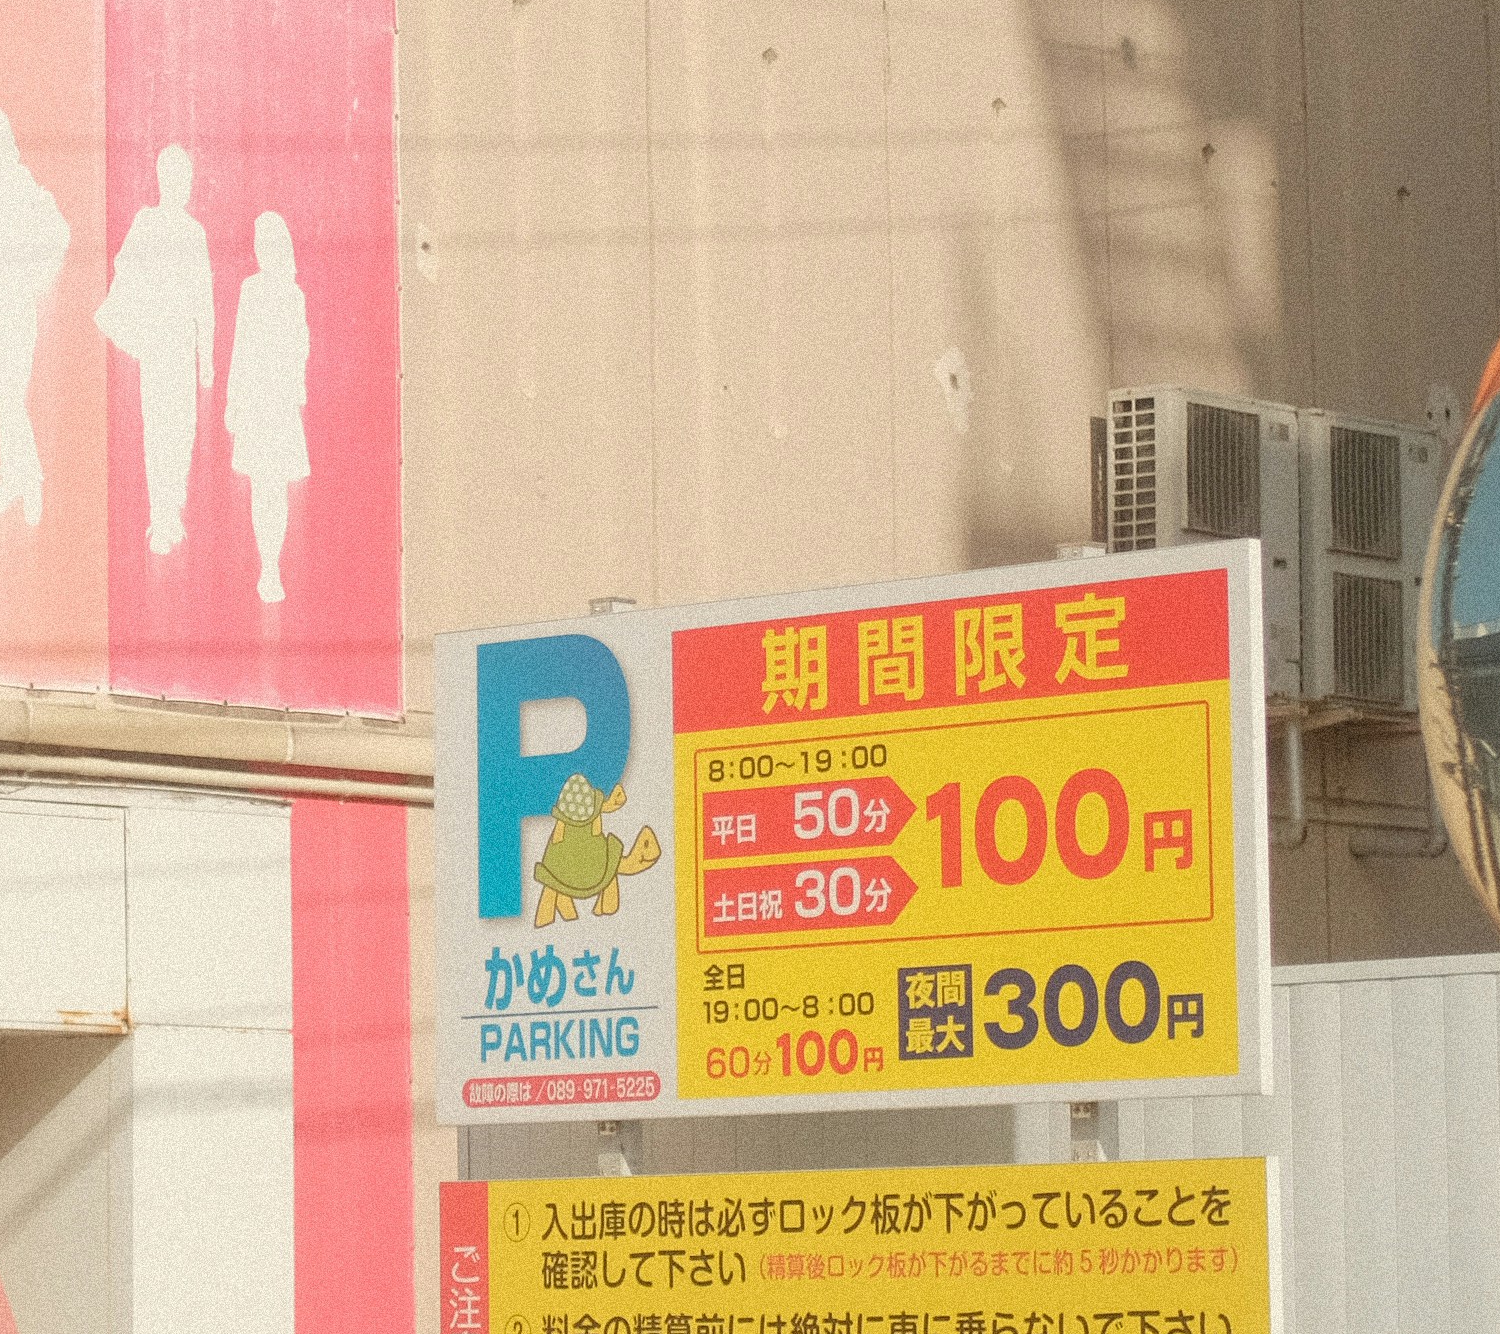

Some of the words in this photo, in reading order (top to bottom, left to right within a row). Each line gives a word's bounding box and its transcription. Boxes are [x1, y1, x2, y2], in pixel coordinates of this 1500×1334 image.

[759, 591, 1131, 716] 期間限定
[711, 813, 757, 846] 平日
[793, 786, 892, 841] 50分
[925, 765, 1194, 889] 100円
[712, 889, 784, 924] 土日祝
[794, 865, 893, 919] 30分
[484, 943, 636, 1012] かめさん
[702, 962, 746, 992] 全日
[904, 969, 967, 1010] 夜間
[982, 958, 1205, 1052] 300円
[480, 1015, 641, 1064] PARKING
[904, 1014, 967, 1055] 最大
[541, 1184, 1232, 1241] 入出庫の時は必ずロック板が下がっていることを
[541, 1249, 747, 1291] 確認して下さい
